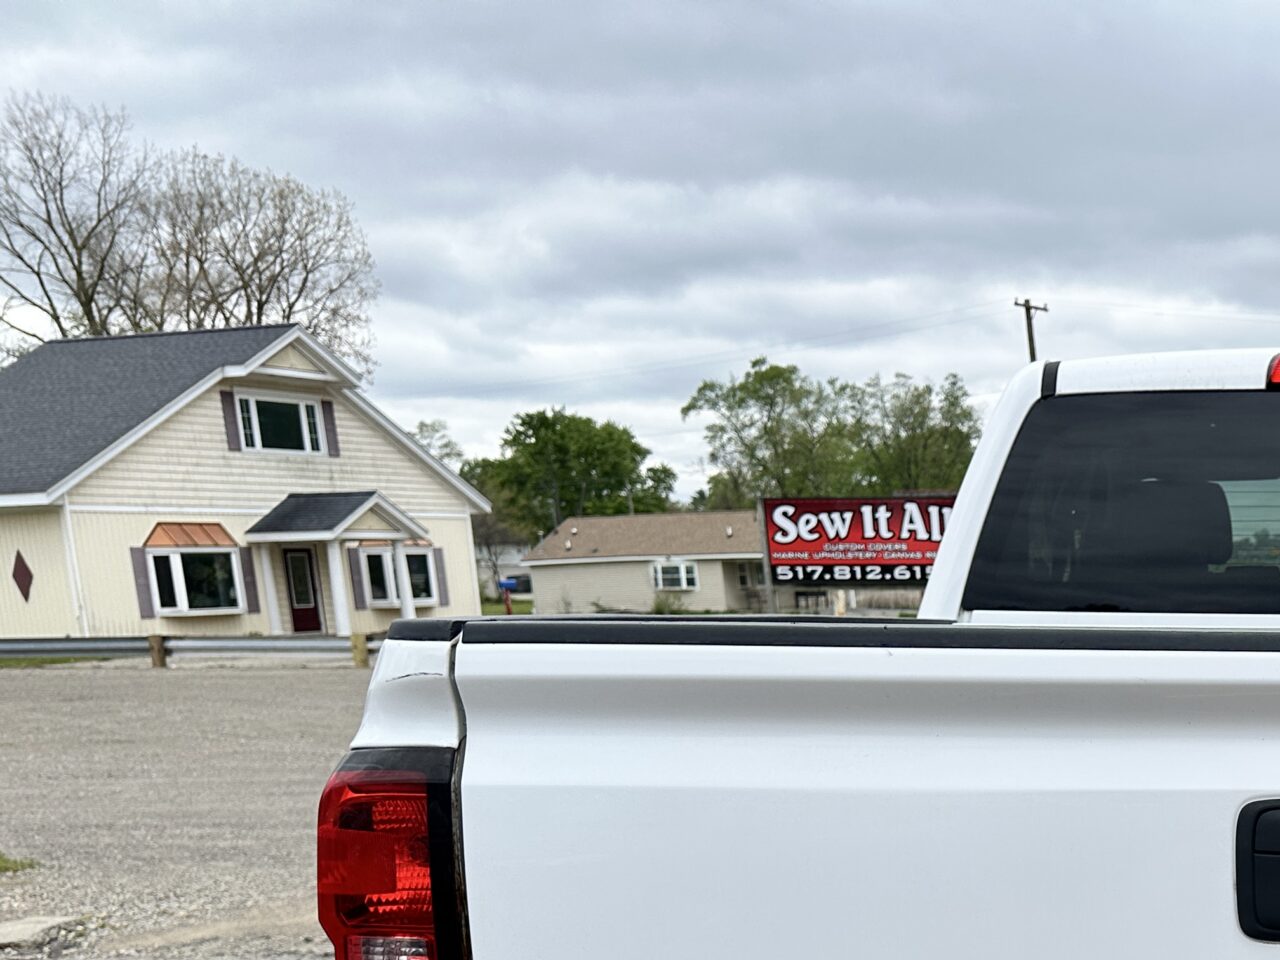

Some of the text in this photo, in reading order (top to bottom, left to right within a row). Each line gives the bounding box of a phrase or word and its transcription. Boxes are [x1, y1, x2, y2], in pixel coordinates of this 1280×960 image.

[772, 504, 853, 544] Sew
[860, 504, 894, 539] It
[823, 542, 907, 551] CUSTOM COVERS
[772, 551, 809, 560] MARINE
[813, 551, 877, 560] UPHOLSTERY
[883, 551, 922, 560] CANVAS
